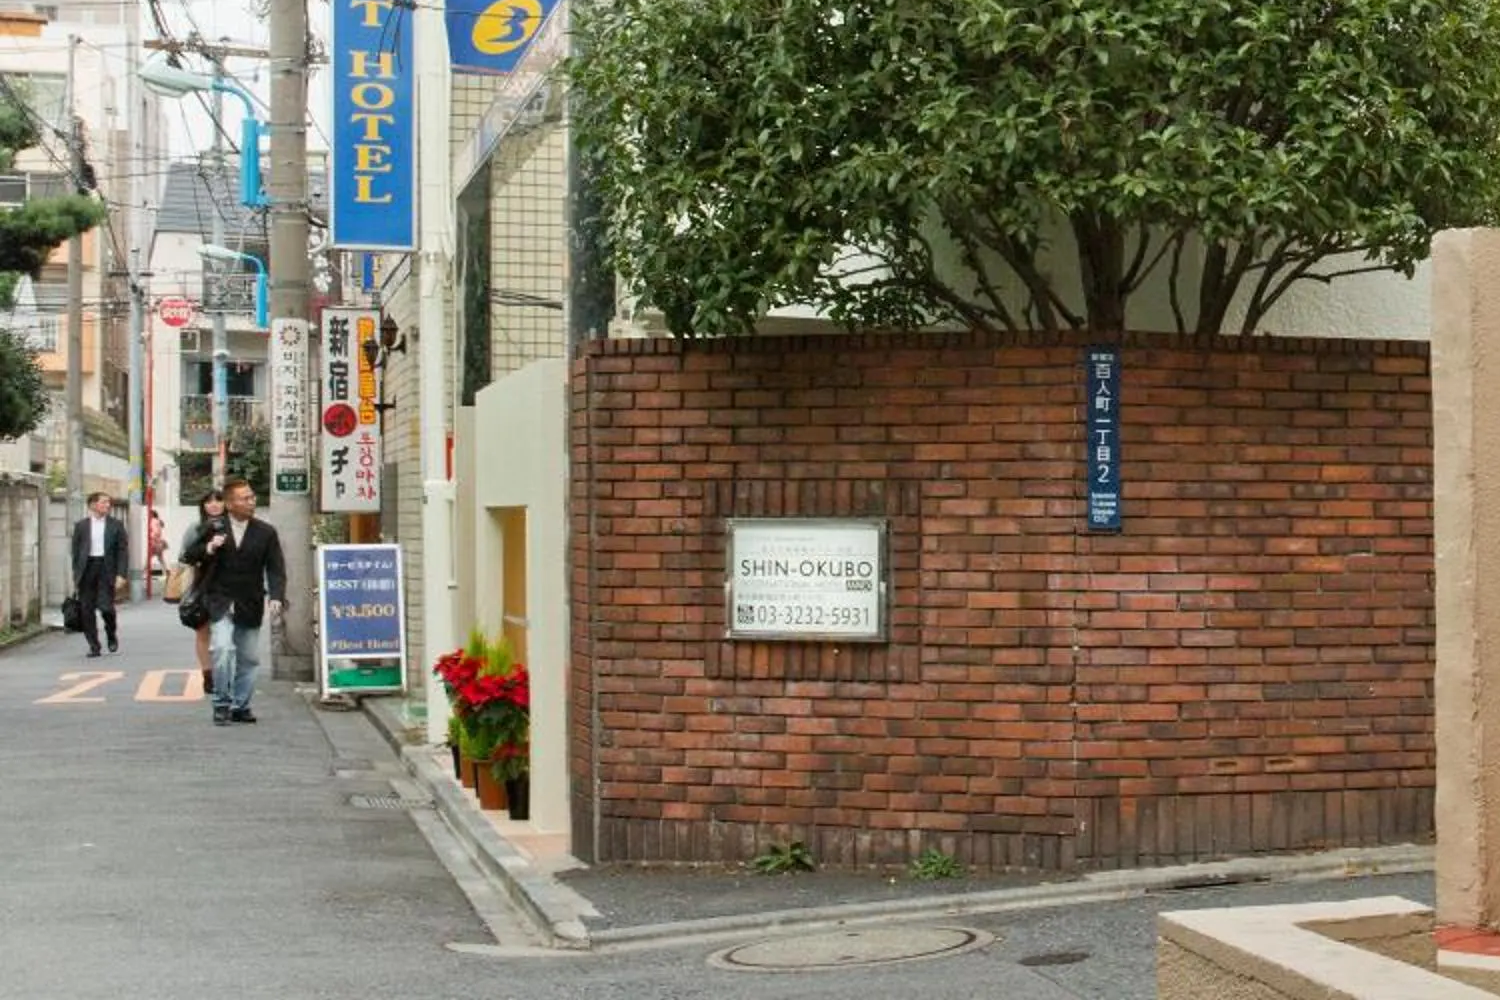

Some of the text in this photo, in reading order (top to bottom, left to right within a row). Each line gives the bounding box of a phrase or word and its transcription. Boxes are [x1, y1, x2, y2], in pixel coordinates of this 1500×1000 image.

[349, 49, 396, 204] HOTEL
[1095, 363, 1112, 483] 百人町一丁目2
[740, 558, 873, 578] SHIN-OKUBO
[757, 604, 870, 626] 03-3232-5931
